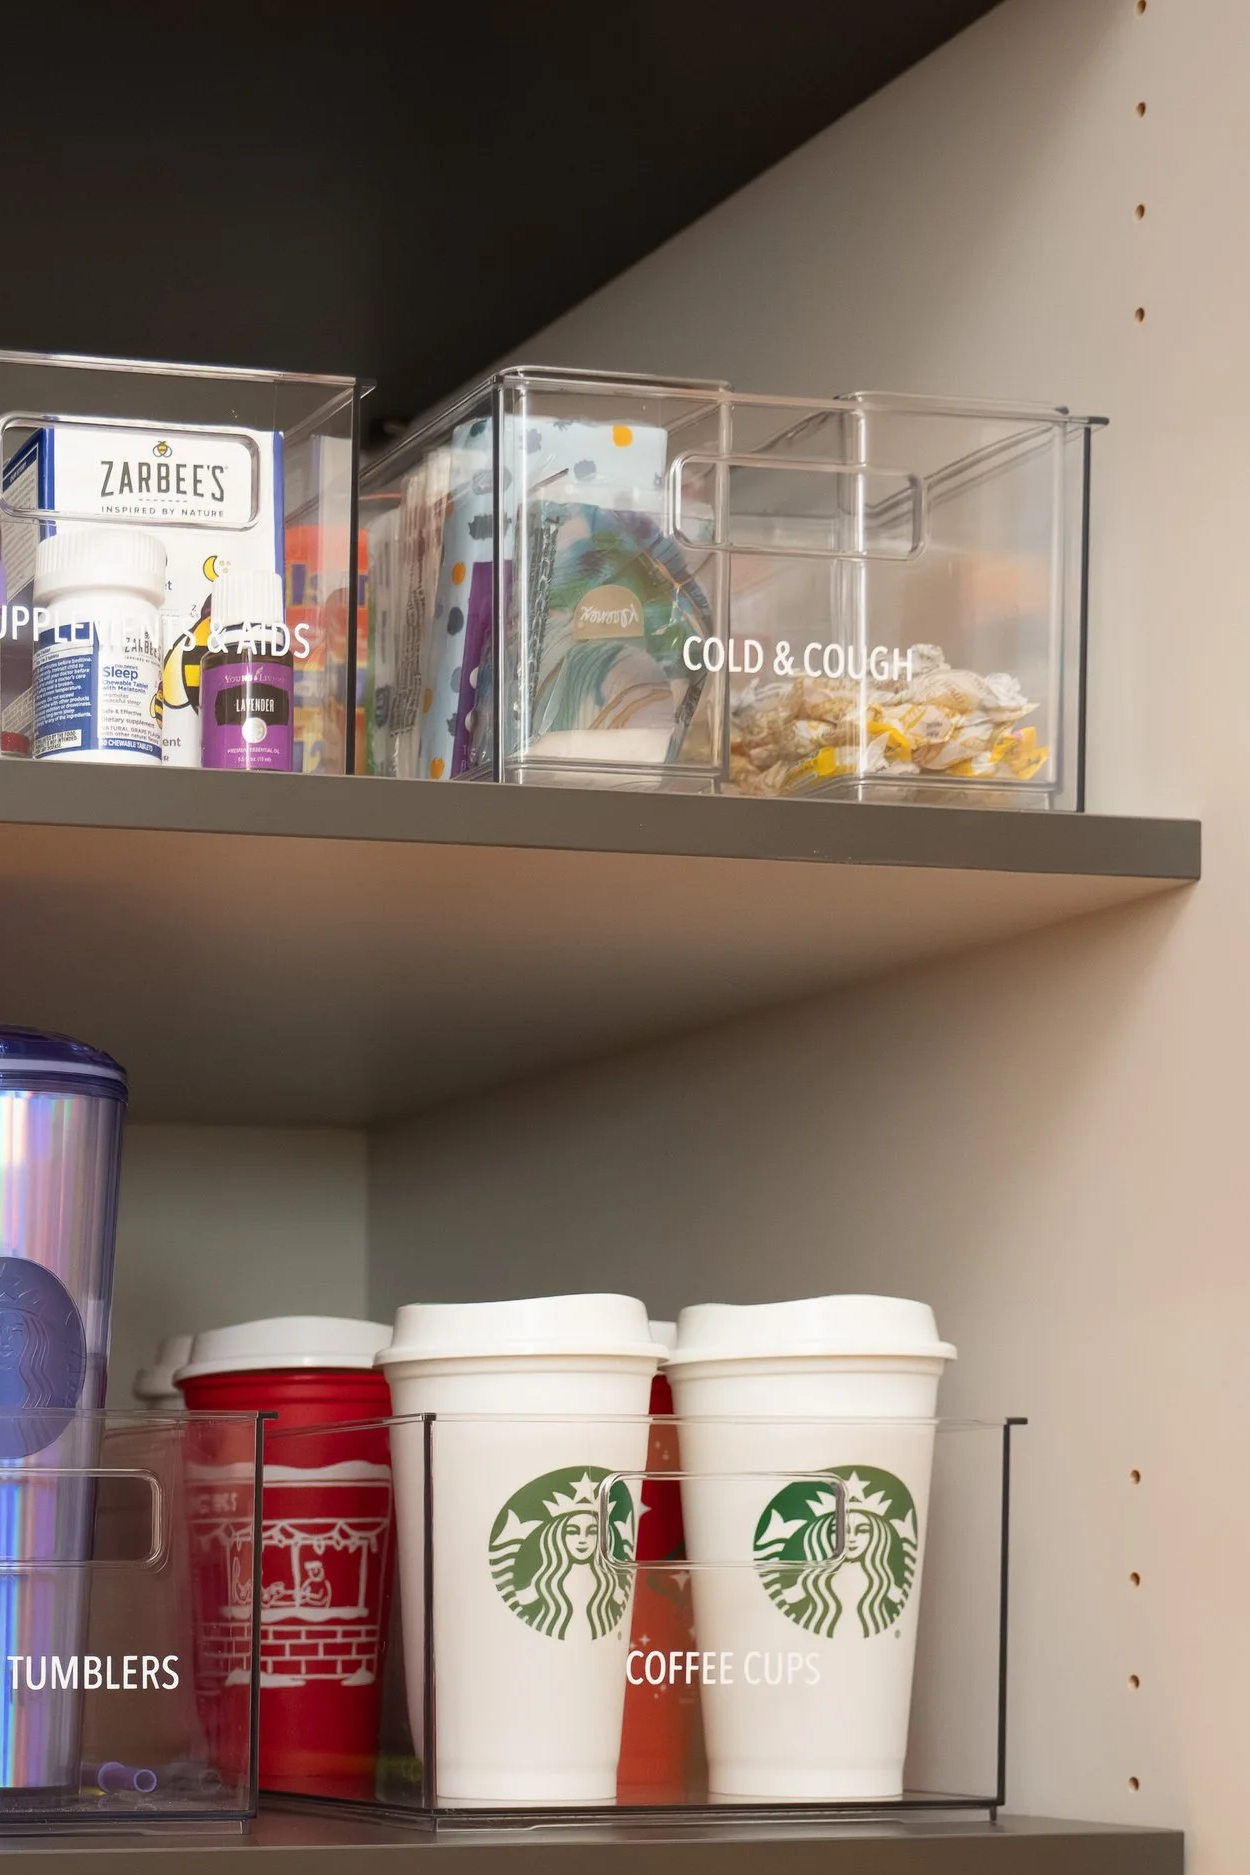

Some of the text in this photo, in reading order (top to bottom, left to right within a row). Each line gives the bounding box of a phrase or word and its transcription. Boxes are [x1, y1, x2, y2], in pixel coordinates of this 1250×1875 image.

[101, 460, 224, 502] ZARBEE'S
[101, 506, 156, 515] INSPIRED
[181, 509, 224, 517] NATURE
[207, 618, 229, 654] &
[238, 621, 311, 659] AIDS
[102, 666, 138, 681] Sleep
[682, 635, 913, 682] COLD & COUGH
[236, 698, 275, 713] LAVENDER
[108, 739, 154, 752] CHEWABLE TABLETS
[6, 1654, 180, 1691] TUMBLERS
[625, 1650, 821, 1686] COFFEE CUPS
